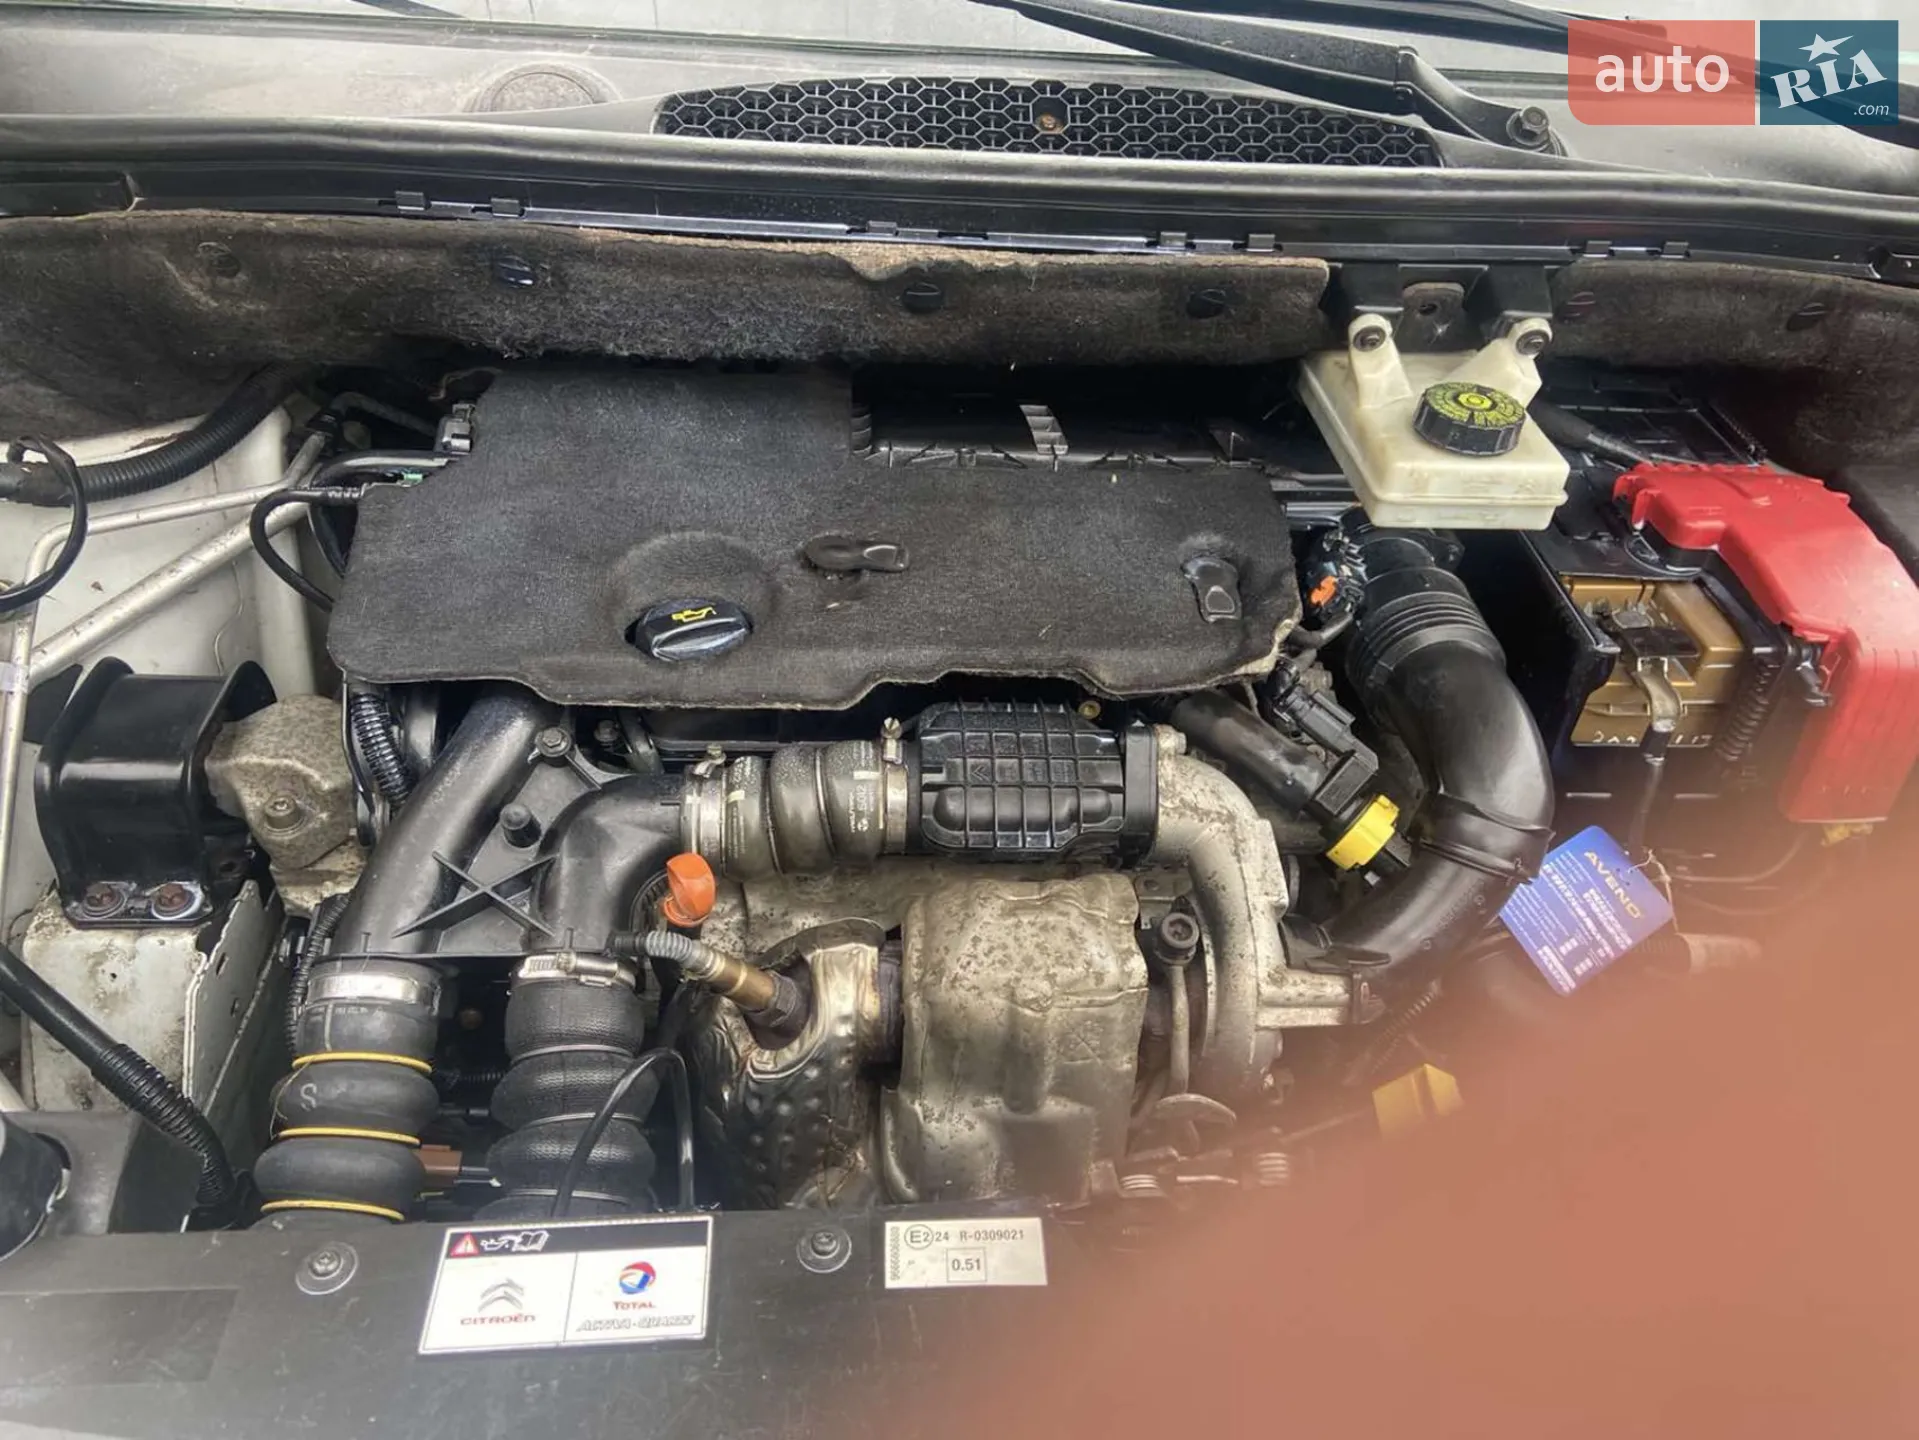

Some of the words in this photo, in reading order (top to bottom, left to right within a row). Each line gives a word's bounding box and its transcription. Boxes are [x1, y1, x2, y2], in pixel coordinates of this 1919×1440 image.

[1584, 850, 1642, 919] AVENO
[934, 1230, 950, 1243] 24
[960, 1229, 1025, 1242] R-0309021
[951, 1257, 982, 1272] 0.51
[613, 1300, 658, 1312] TOTAL
